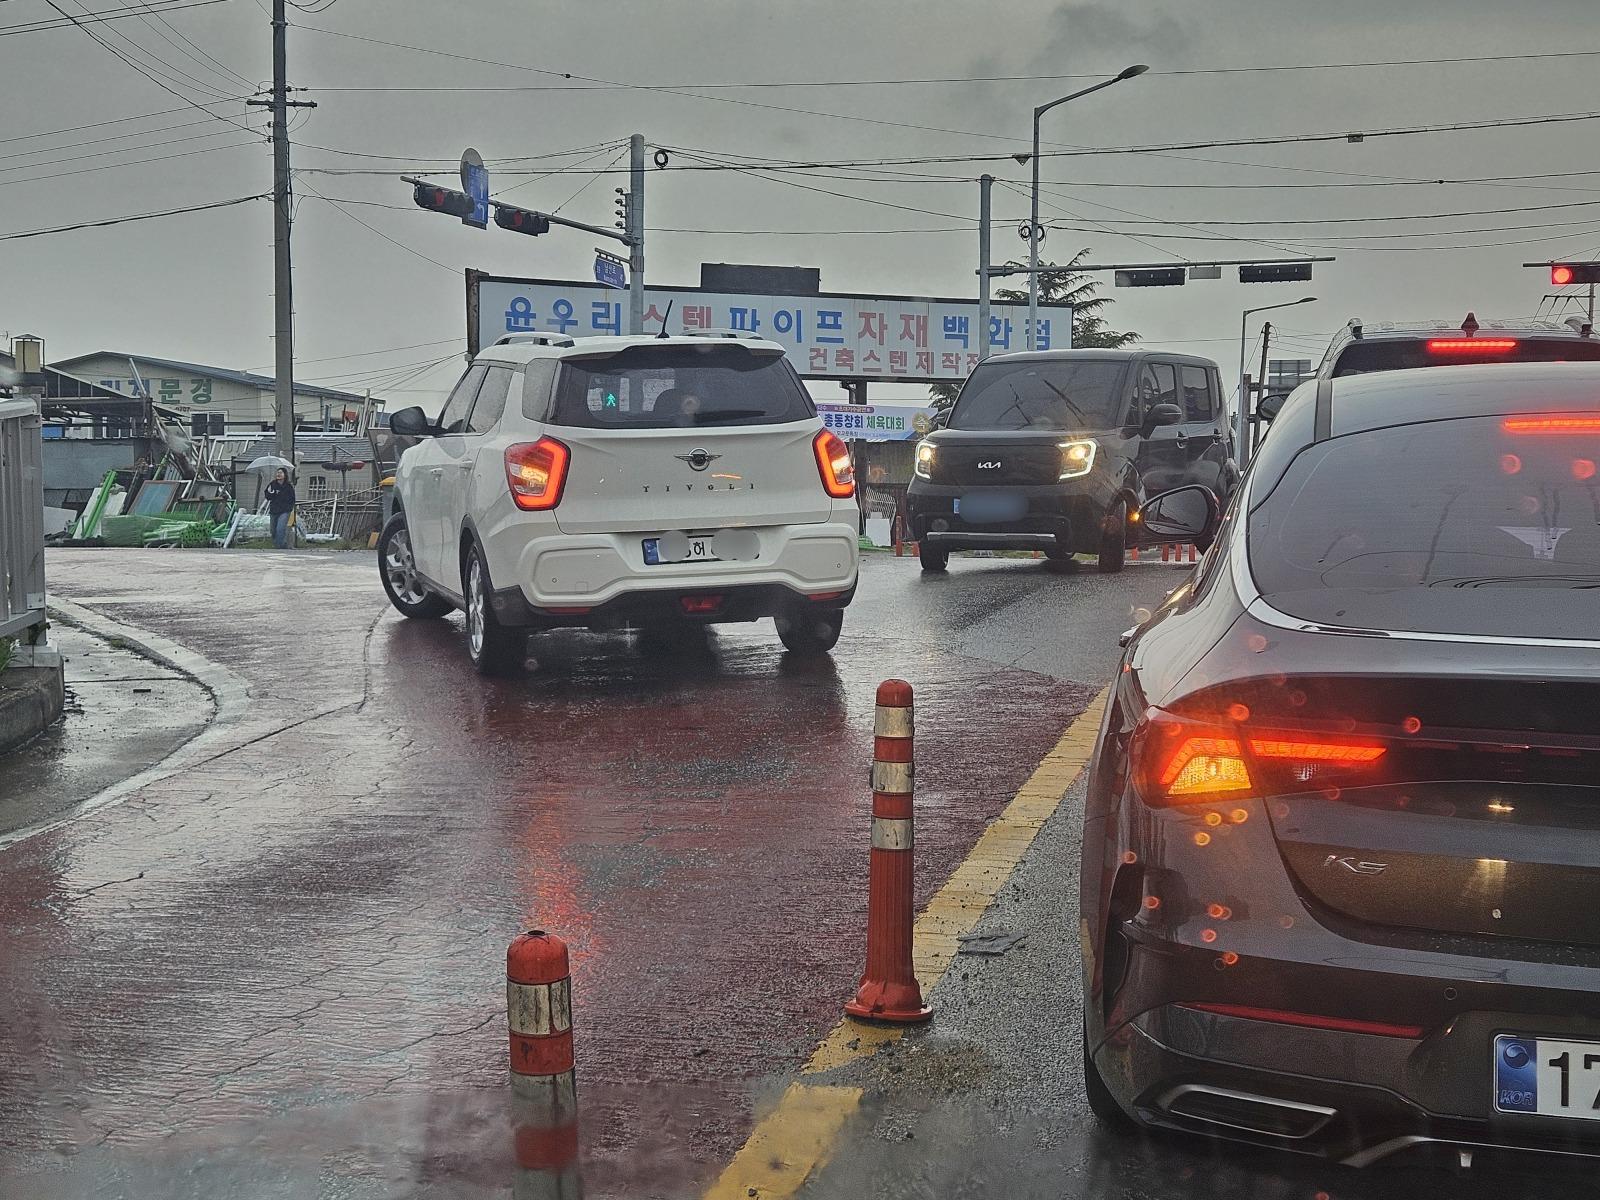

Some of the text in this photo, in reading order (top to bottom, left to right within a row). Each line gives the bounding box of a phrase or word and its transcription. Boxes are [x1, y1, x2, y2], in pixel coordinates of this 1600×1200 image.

[824, 413, 905, 430] 총동창회 체육대회
[643, 483, 755, 493] TIVOLI
[1323, 854, 1389, 875] K5
[1500, 1089, 1534, 1106] KOR
